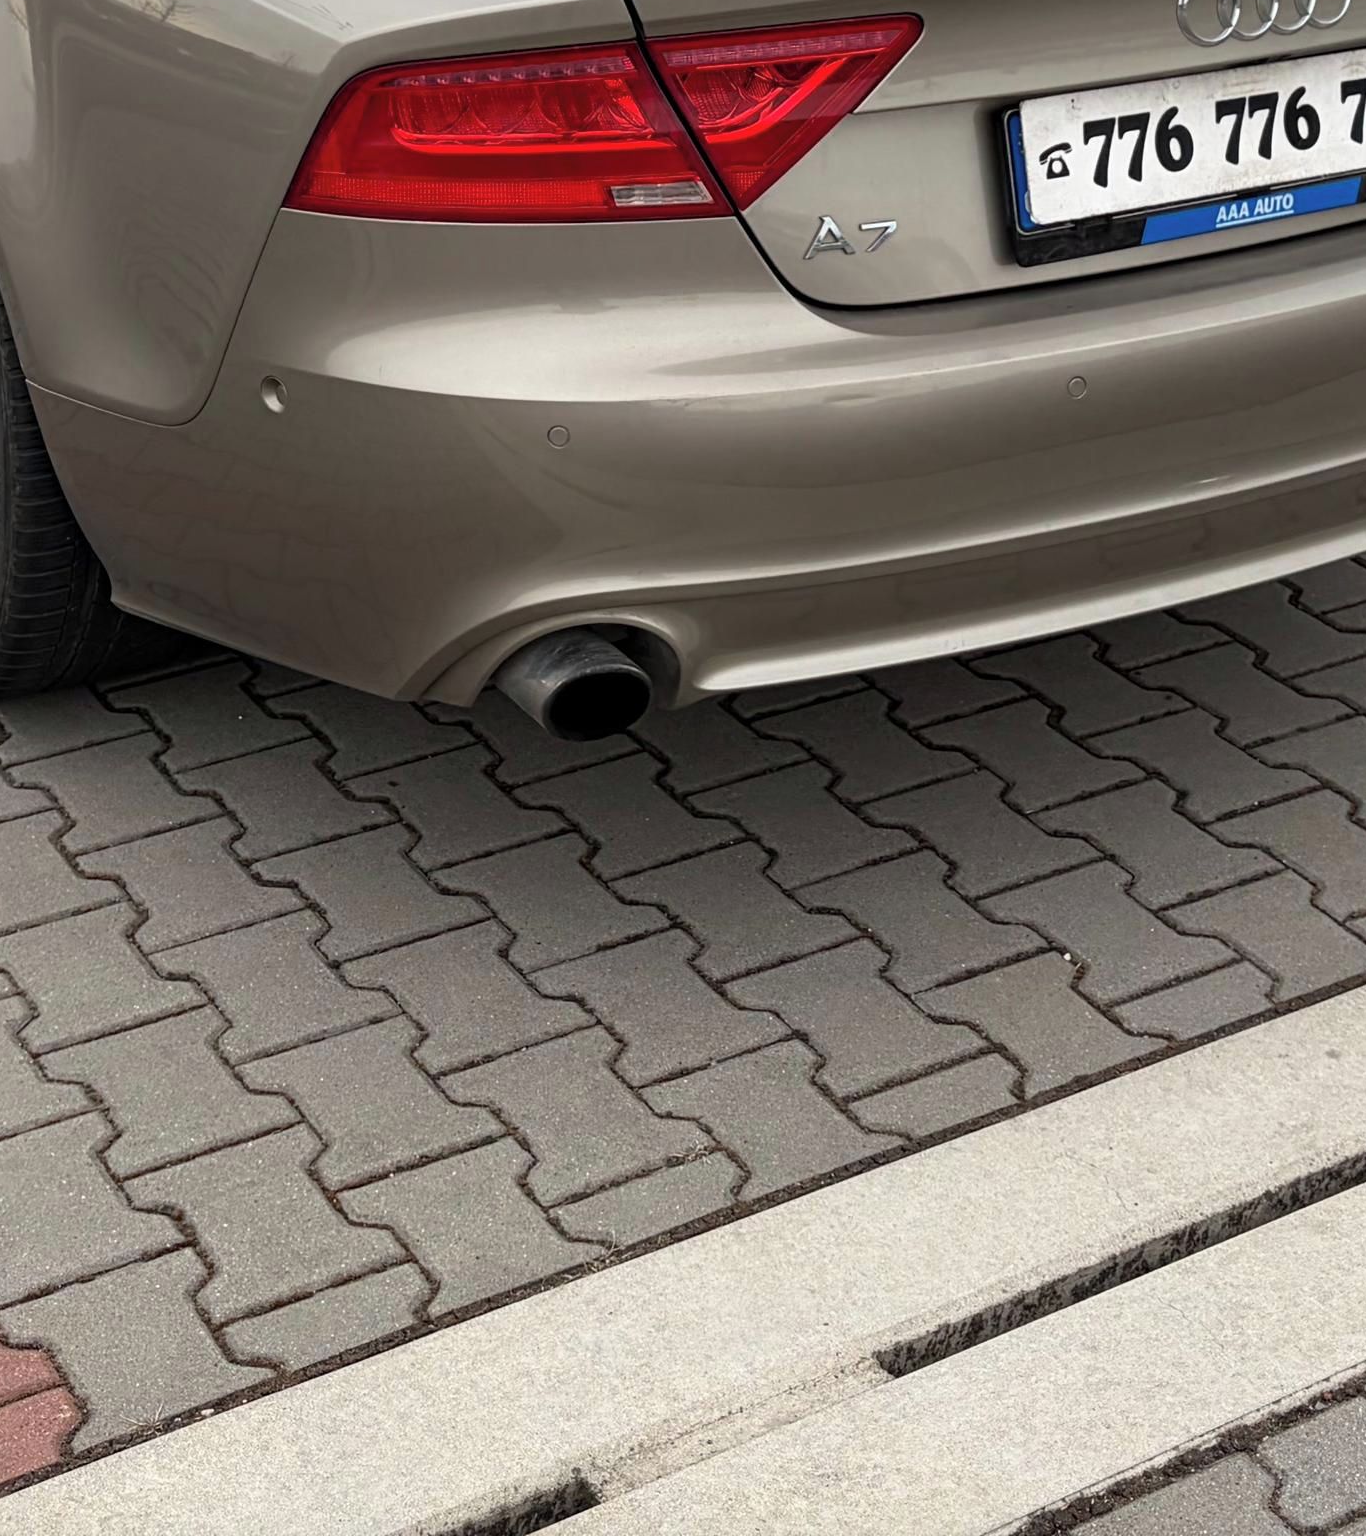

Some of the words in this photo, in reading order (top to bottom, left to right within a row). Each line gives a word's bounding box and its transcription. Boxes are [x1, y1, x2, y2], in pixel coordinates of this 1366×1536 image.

[1083, 106, 1194, 188] 776
[1215, 86, 1321, 165] 776
[1216, 205, 1250, 223] AAA
[1253, 192, 1294, 216] AUTO
[803, 215, 897, 260] A7
